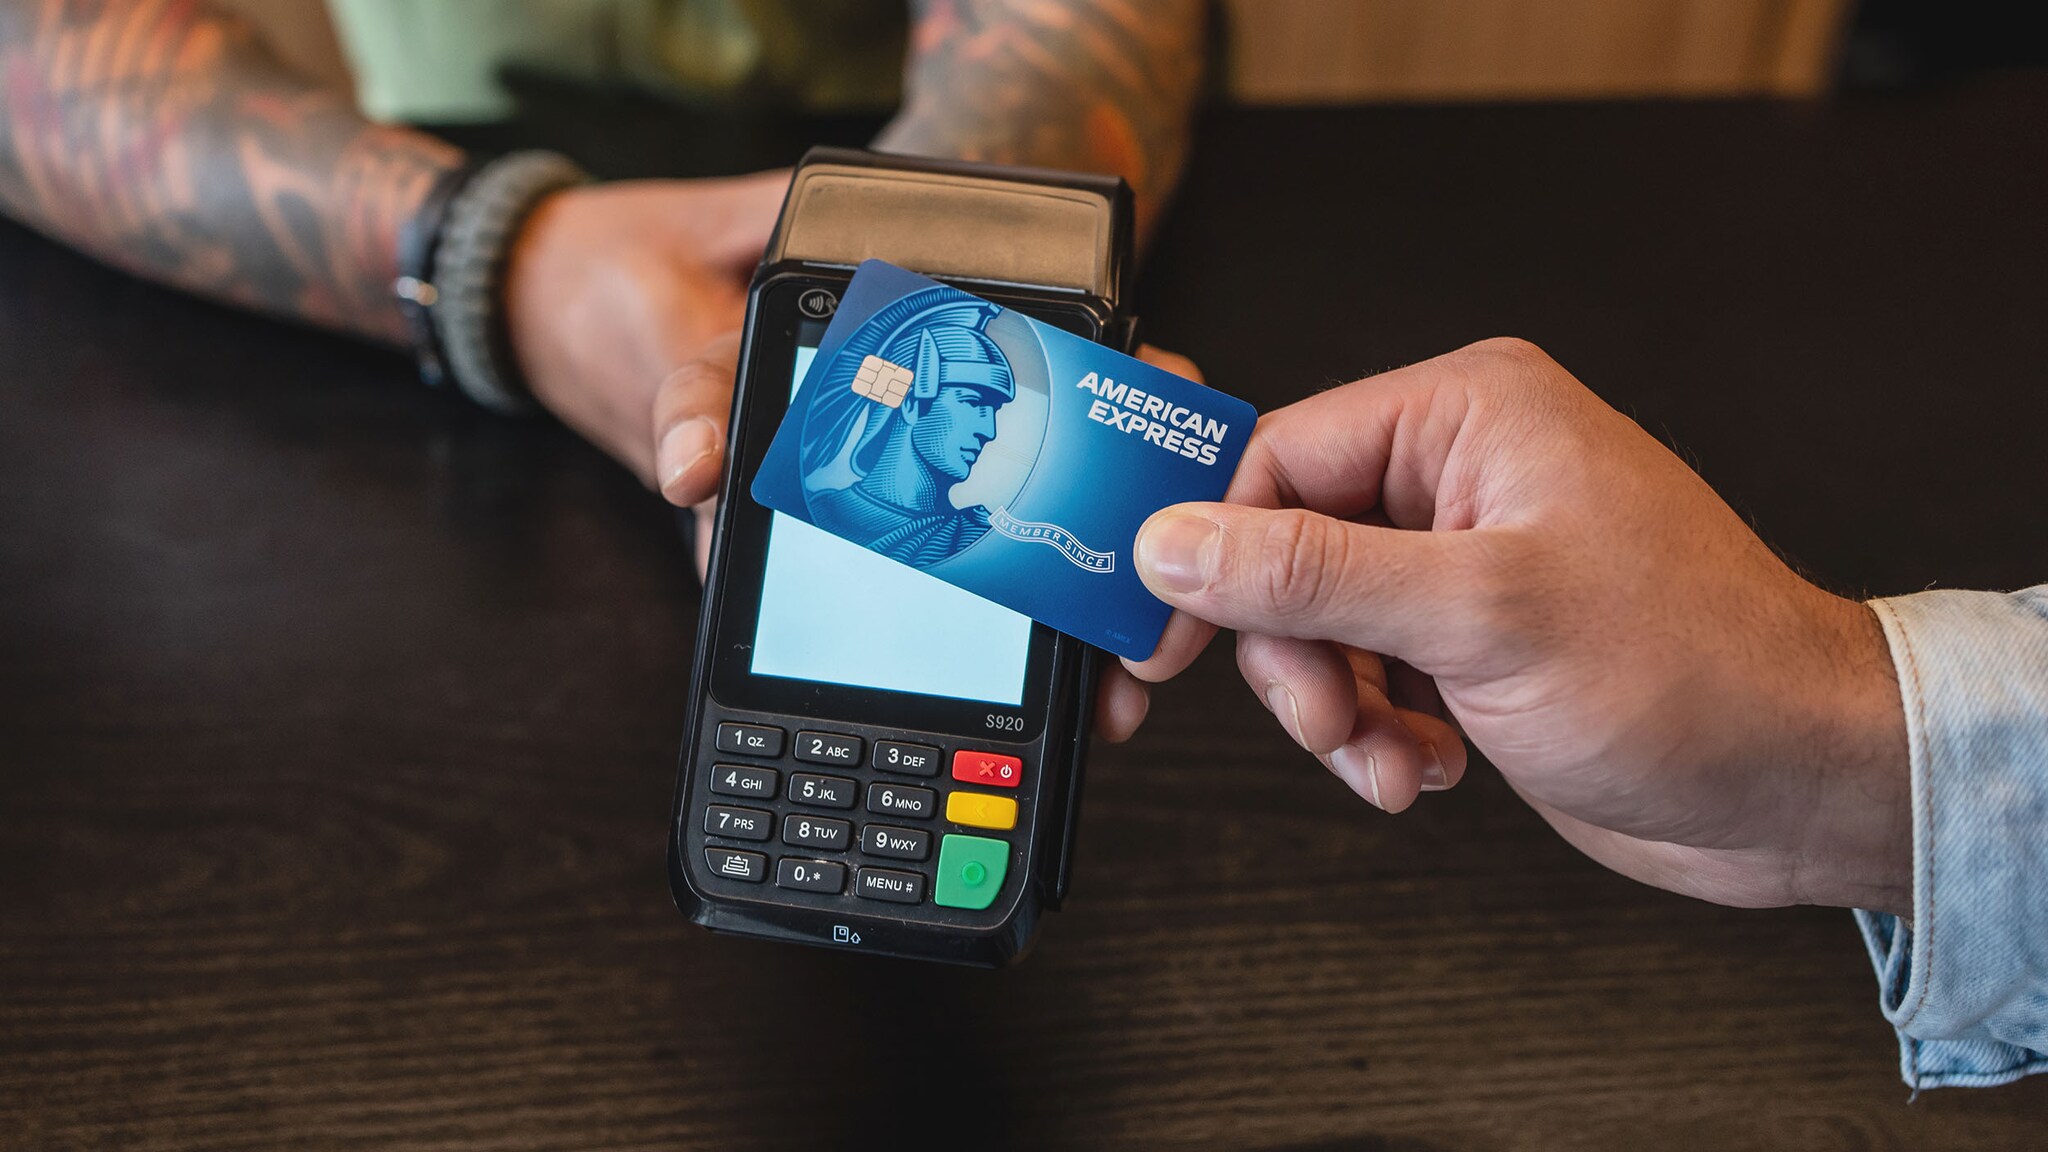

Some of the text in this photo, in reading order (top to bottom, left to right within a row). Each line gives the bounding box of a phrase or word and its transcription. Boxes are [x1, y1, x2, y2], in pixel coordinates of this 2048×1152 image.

[1076, 371, 1228, 444] AMERICAN
[1087, 399, 1221, 466] EXPRESS
[1000, 517, 1105, 567] MEMBER SINCE
[986, 714, 1024, 732] S920
[734, 730, 742, 746] 1
[810, 739, 850, 759] 2 ABC
[887, 748, 926, 768] 3 DEF
[725, 771, 762, 791] 4 GHI
[802, 781, 837, 802] 5 JKL
[881, 790, 922, 812] 6 MNO
[718, 813, 754, 831] 7 PRS
[798, 821, 838, 840] 8 TUV
[875, 831, 917, 852] 9 WXY
[866, 876, 914, 894] MENU #
